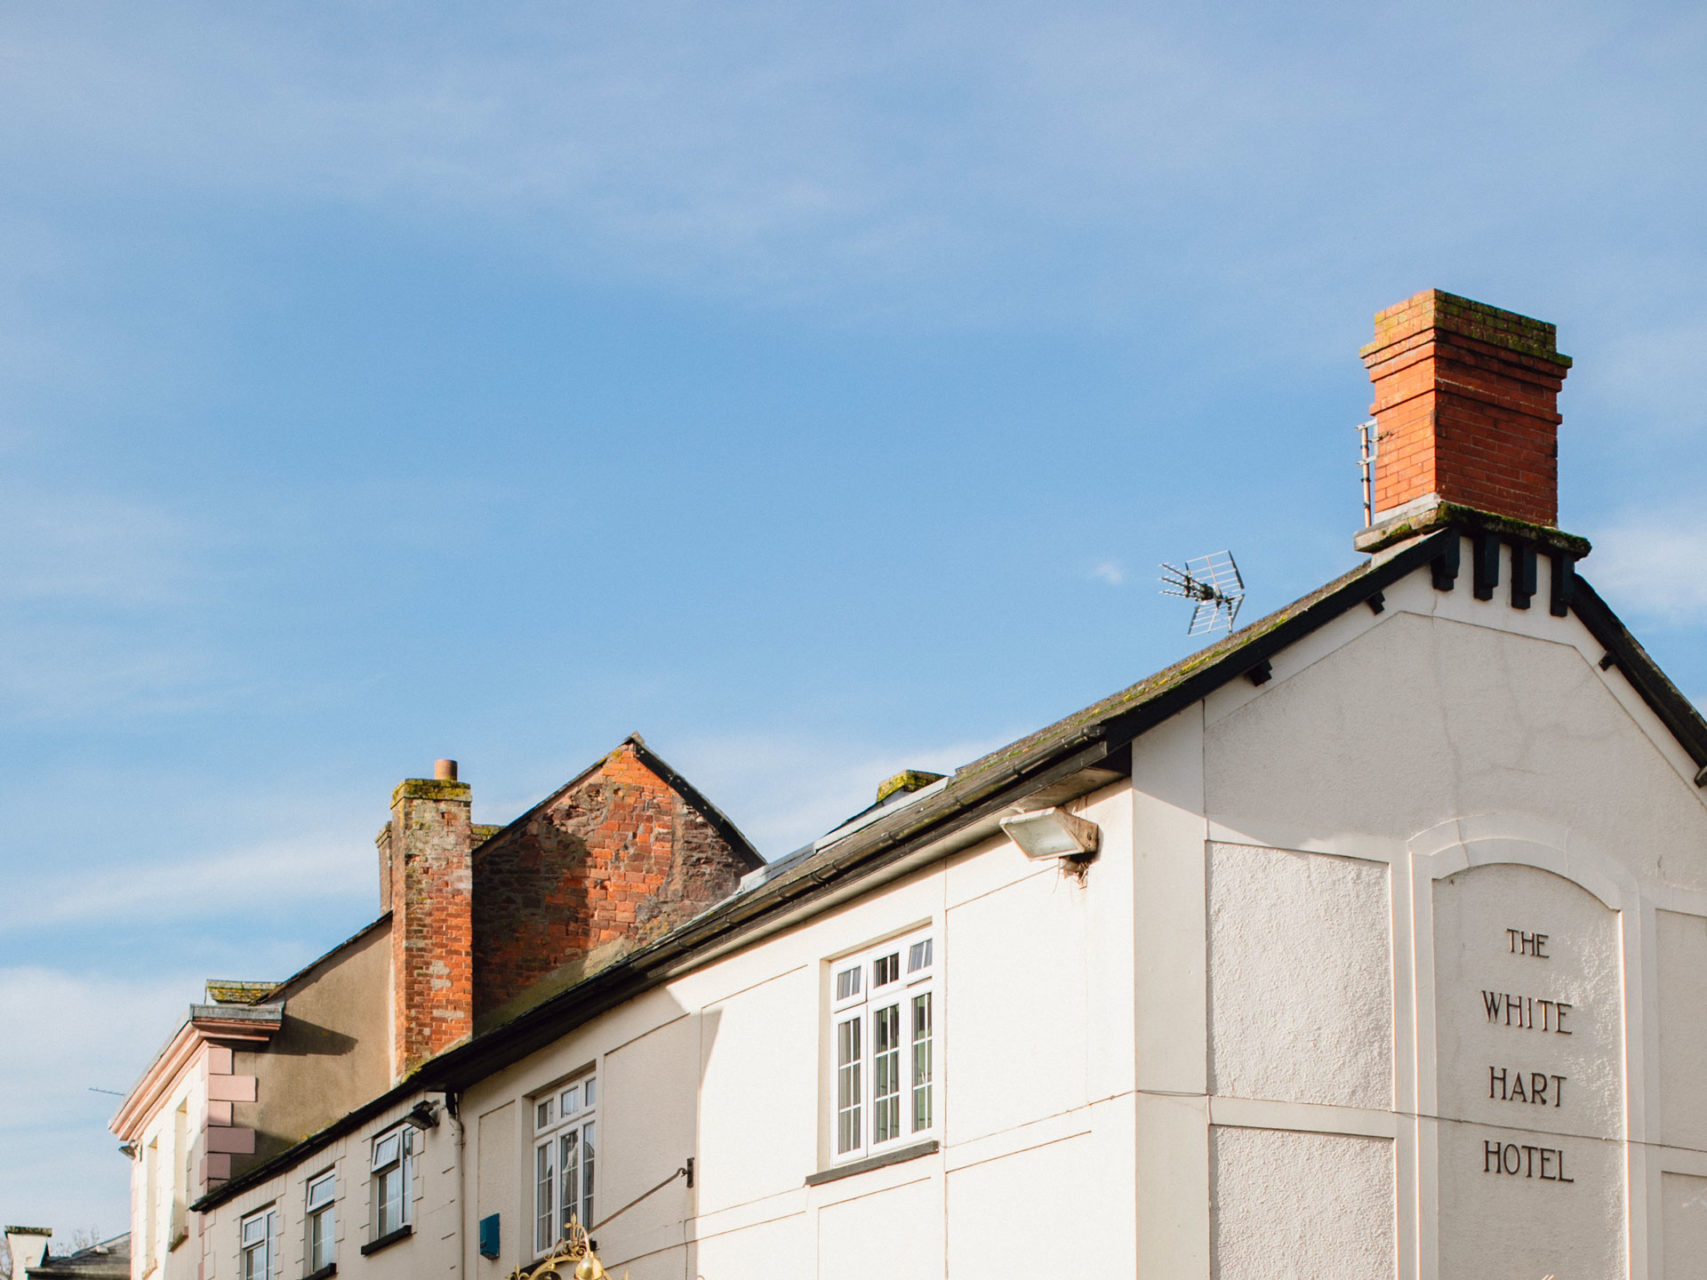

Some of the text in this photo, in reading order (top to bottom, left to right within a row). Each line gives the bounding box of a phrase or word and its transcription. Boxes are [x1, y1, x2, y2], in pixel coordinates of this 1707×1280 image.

[1506, 928, 1550, 959] THE
[1481, 990, 1573, 1035] WHITE
[1488, 1066, 1567, 1108] HART
[1483, 1140, 1574, 1183] HOTEL
